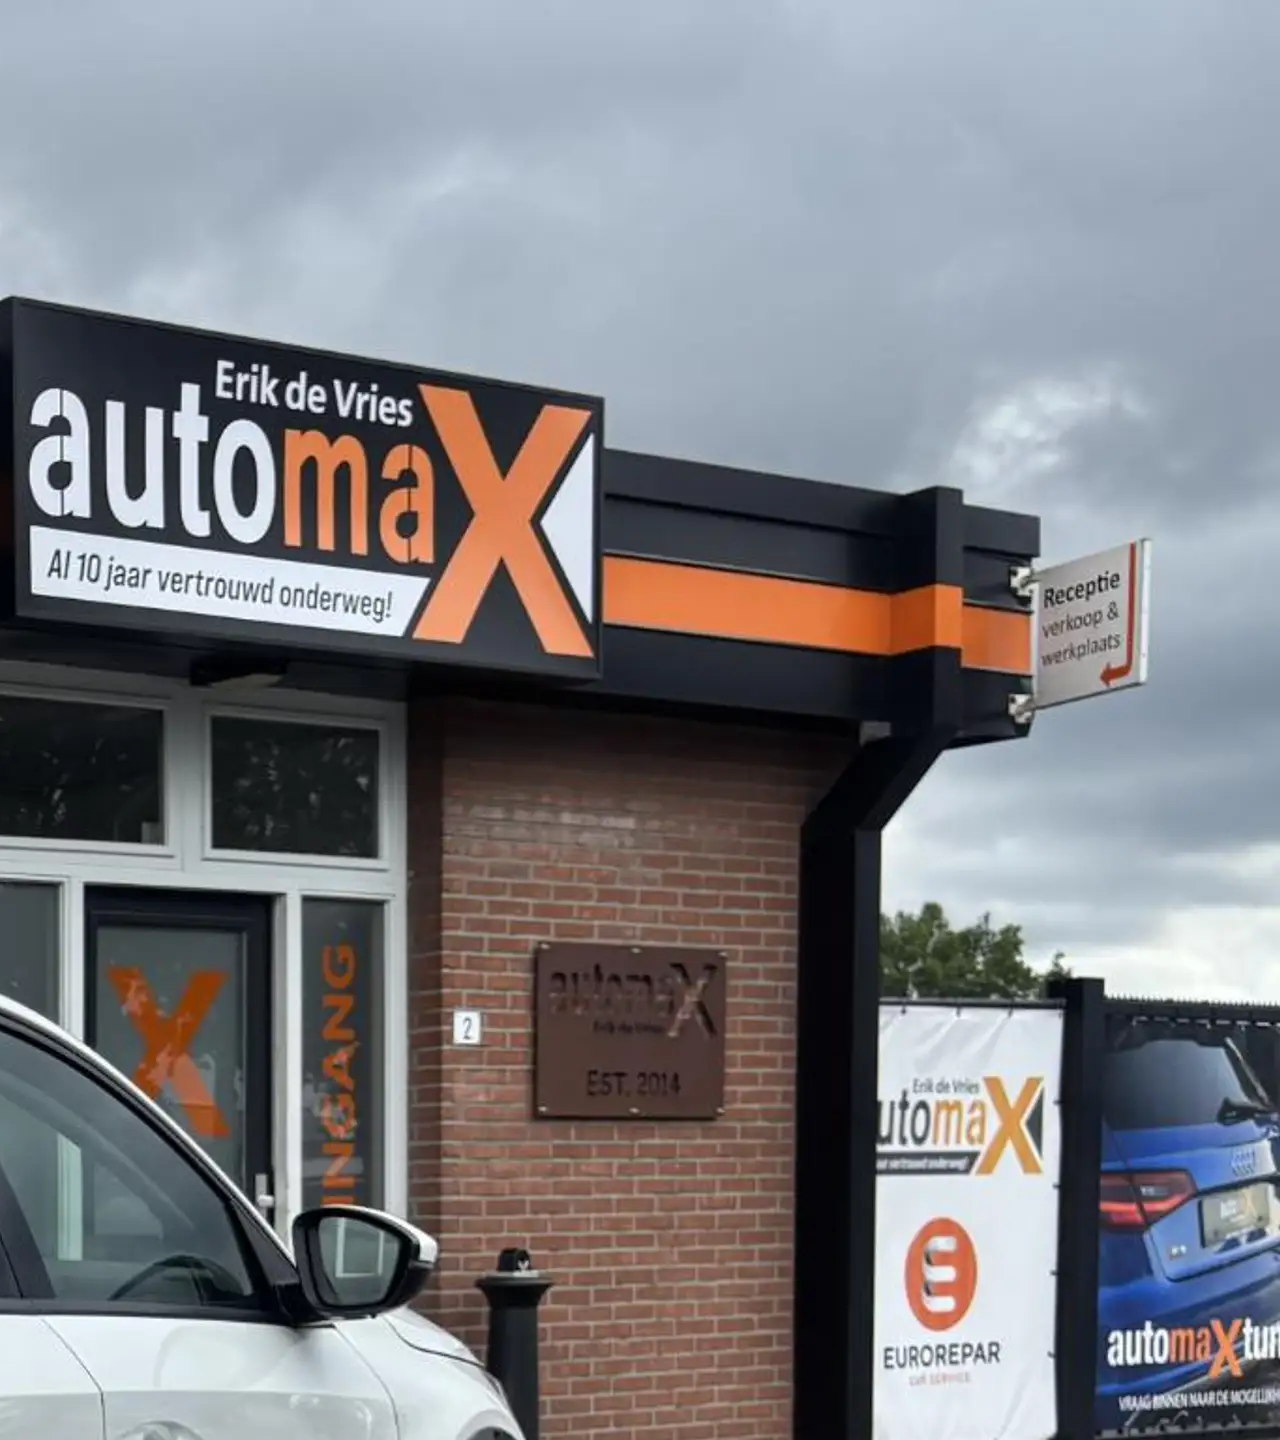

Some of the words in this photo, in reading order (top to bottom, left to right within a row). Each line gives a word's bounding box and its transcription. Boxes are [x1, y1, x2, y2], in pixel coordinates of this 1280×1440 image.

[215, 360, 280, 407] Erik
[285, 371, 327, 413] de
[333, 379, 413, 427] Vries
[29, 382, 594, 659] automaX
[47, 549, 69, 580] Al
[79, 554, 100, 583] 10
[104, 556, 152, 591] jaar
[158, 569, 274, 604] vertrouwd
[280, 583, 392, 623] onderweg!
[1043, 570, 1120, 608] Receptie
[1042, 610, 1103, 639] verkoop
[1107, 601, 1120, 620] &
[1041, 633, 1121, 666] werkplaats
[462, 1017, 472, 1040] 2
[637, 1072, 681, 1096] 2014
[877, 1076, 1043, 1176] utomaX
[883, 1341, 1000, 1369] EUROREPAR
